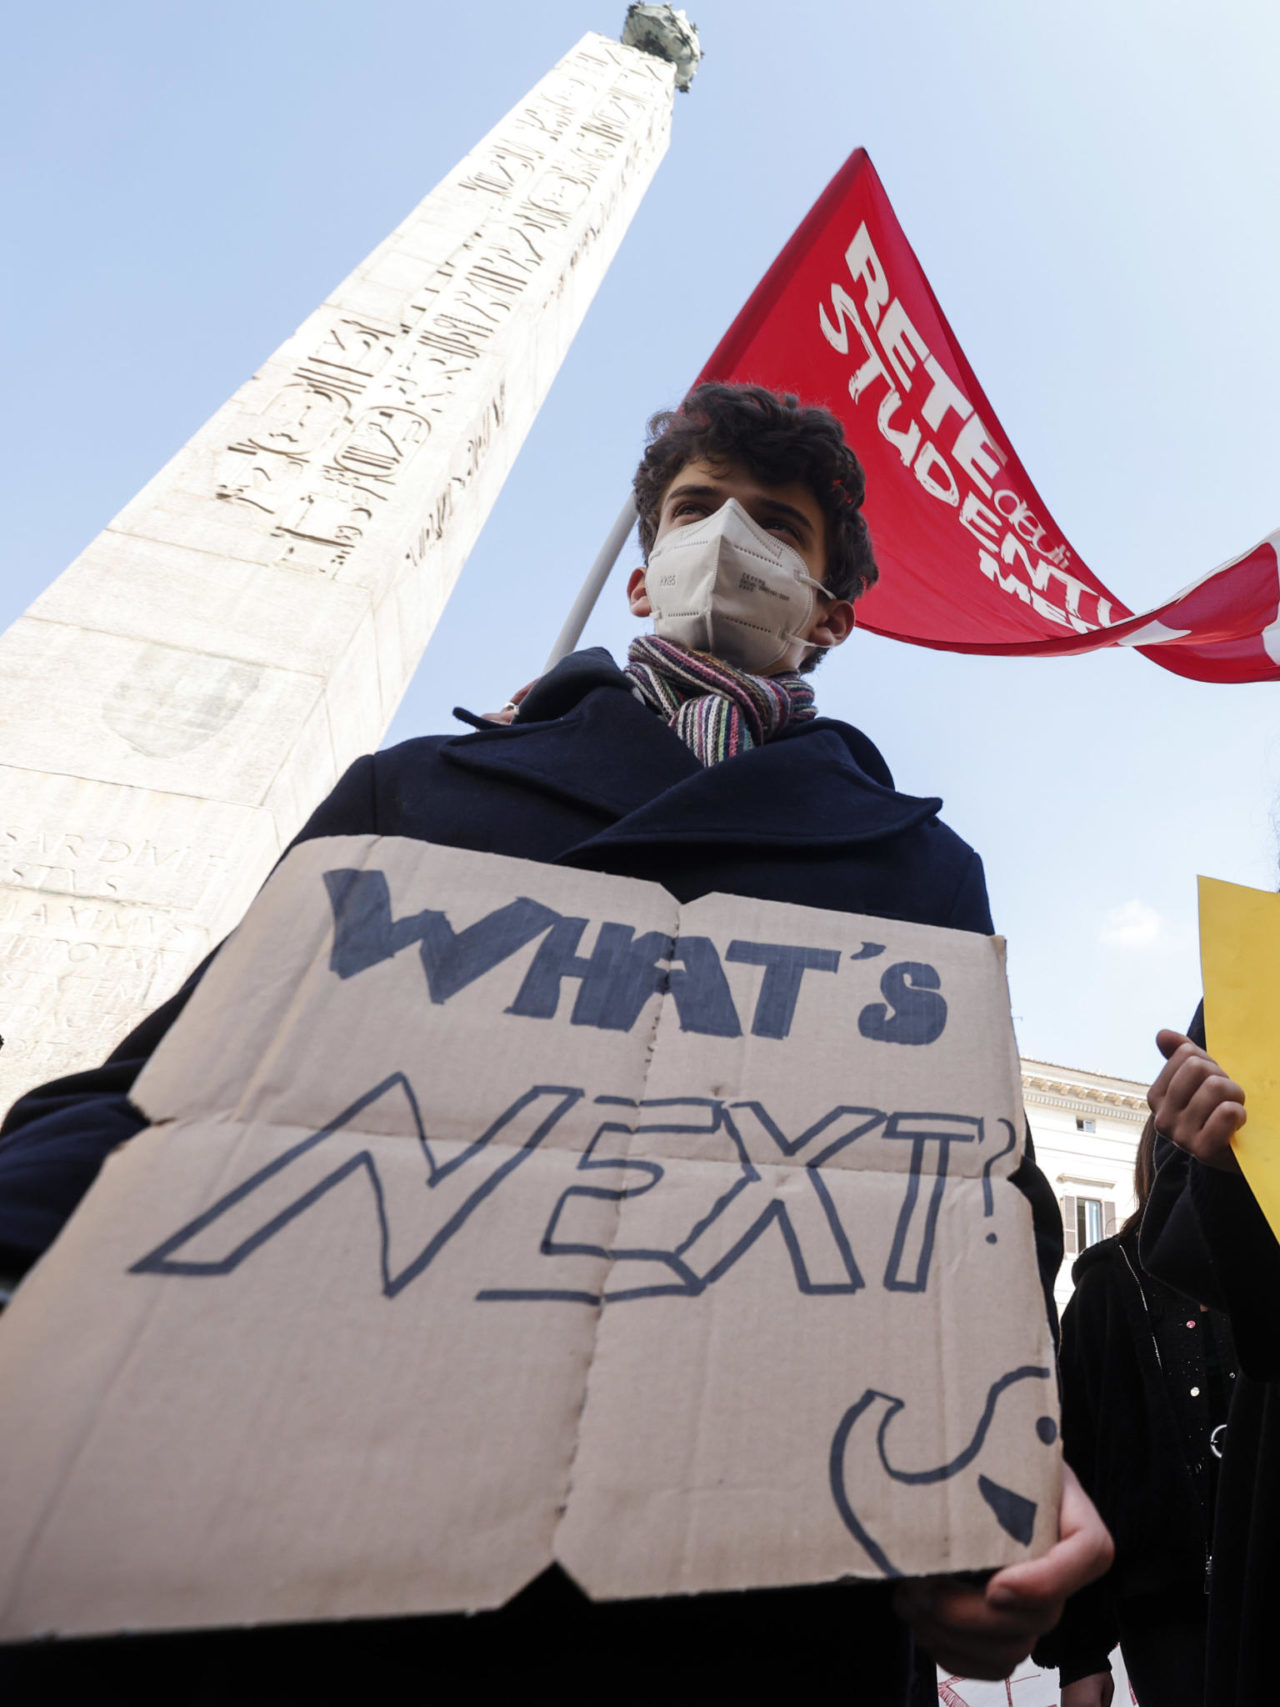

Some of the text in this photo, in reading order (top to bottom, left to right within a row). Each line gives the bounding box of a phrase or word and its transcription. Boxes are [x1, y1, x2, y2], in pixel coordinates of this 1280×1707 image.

[819, 282, 1113, 629] STUDENTI
[844, 220, 1008, 499] RETE
[322, 867, 949, 1046] WHAT'S
[127, 1071, 1017, 1307] NEXT?
